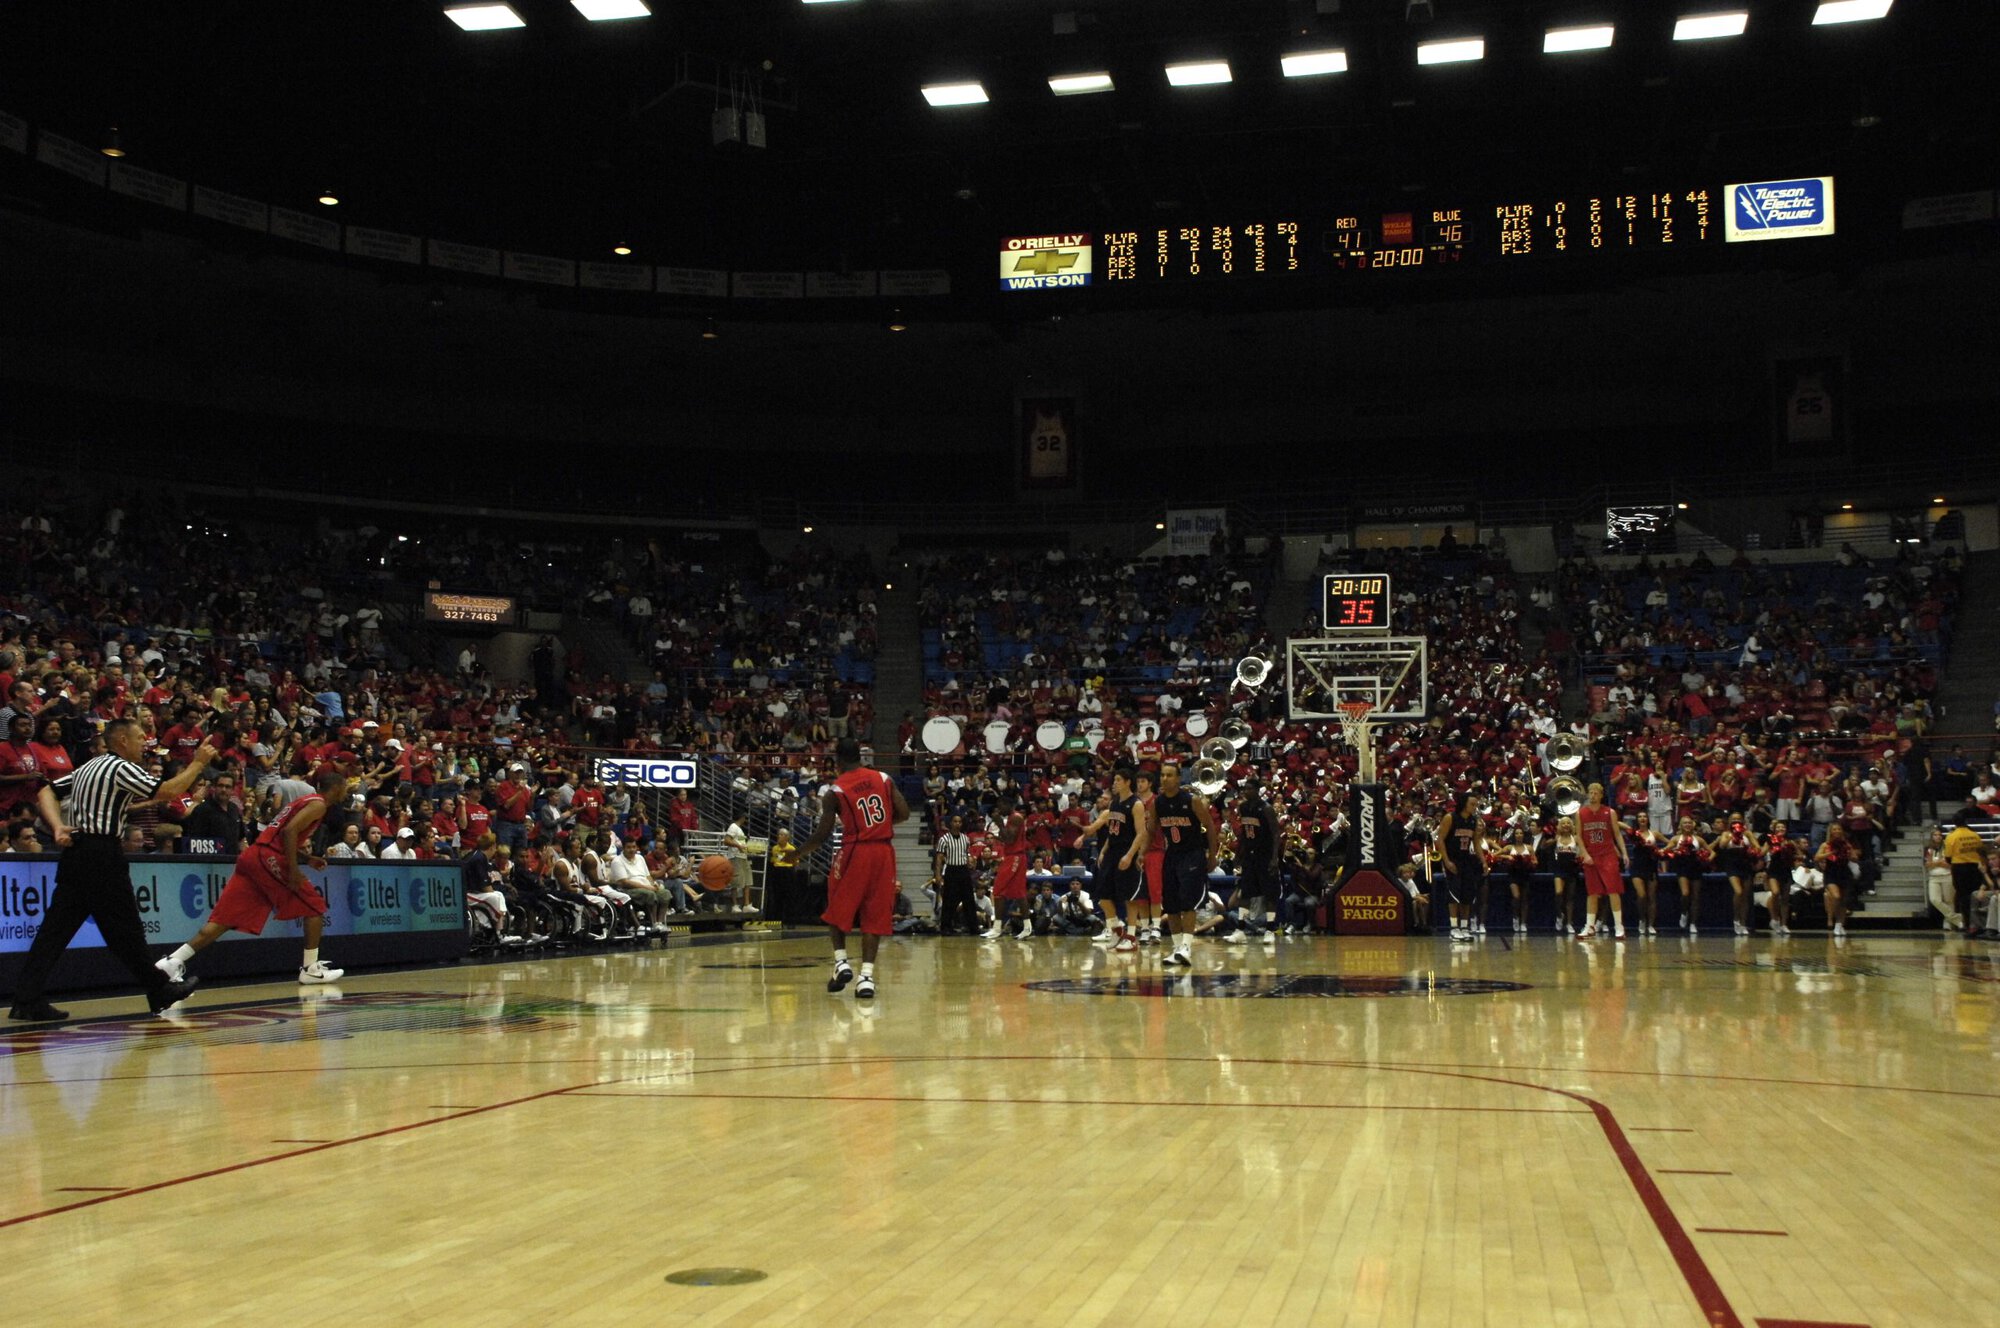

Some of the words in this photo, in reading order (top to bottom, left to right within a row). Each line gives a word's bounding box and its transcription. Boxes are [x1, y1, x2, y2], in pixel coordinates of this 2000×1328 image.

[1755, 187, 1805, 200] Tucson
[1496, 204, 1533, 218] PLYR
[1555, 202, 1565, 213] 0
[1590, 199, 1600, 210] 2
[1617, 196, 1636, 209] 12
[1652, 192, 1672, 206] 14
[1686, 190, 1708, 203] 44
[1761, 196, 1816, 210] Electric
[1336, 217, 1357, 230] RED
[1432, 209, 1461, 223] BLUE
[1503, 217, 1529, 230] PTS
[1697, 202, 1709, 215] 5
[1765, 208, 1816, 222] Power
[1104, 232, 1138, 245] PLYR
[1158, 230, 1168, 241] 5
[1180, 228, 1200, 240] 20
[1212, 226, 1232, 238] 34
[1245, 224, 1265, 236] 42
[1277, 222, 1298, 235] 50
[1439, 224, 1463, 242] 46
[1501, 229, 1531, 243] RBS
[1555, 226, 1566, 238] 0
[1591, 224, 1601, 235] 0
[1628, 222, 1632, 233] 1
[1662, 218, 1673, 230] 7
[1698, 215, 1709, 227] 4
[1008, 235, 1083, 250] O'RIELLY
[1110, 244, 1134, 257] PTS
[1190, 240, 1200, 251] 2
[1255, 236, 1265, 248] 6
[1288, 234, 1298, 246] 4
[1338, 231, 1361, 249] 41
[1501, 241, 1532, 255] FLS
[1556, 238, 1566, 250] 4
[1591, 236, 1601, 248] 0
[1628, 235, 1632, 245] 1
[1662, 230, 1673, 243] 2
[1700, 228, 1705, 240] 1
[1108, 256, 1136, 268] RBS
[1192, 252, 1196, 263] 1
[1222, 250, 1232, 261] 0
[1255, 248, 1265, 260] 3
[1290, 246, 1294, 258] 1
[1372, 248, 1424, 268] 20:00
[1108, 268, 1136, 280] FLS
[1160, 265, 1164, 277] 1
[1190, 263, 1200, 275] 0
[1222, 262, 1232, 273] 0
[1255, 260, 1265, 272] 2
[1288, 258, 1298, 270] 3
[1008, 275, 1084, 289] WATSON
[1036, 435, 1061, 452] 32
[1364, 506, 1387, 516] HALL
[1391, 505, 1405, 516] OF
[1407, 504, 1465, 515] CHAMPIONS
[1332, 580, 1381, 595] 20:00
[444, 610, 498, 621] 327-7463
[1340, 600, 1374, 624] 35
[597, 763, 694, 784] GEICO
[856, 794, 886, 828] 13
[1360, 790, 1375, 864] ARIZONA
[191, 839, 217, 854] POSS.
[1341, 895, 1398, 907] WELLS
[370, 912, 402, 926] wireless
[1343, 909, 1397, 920] FARGO
